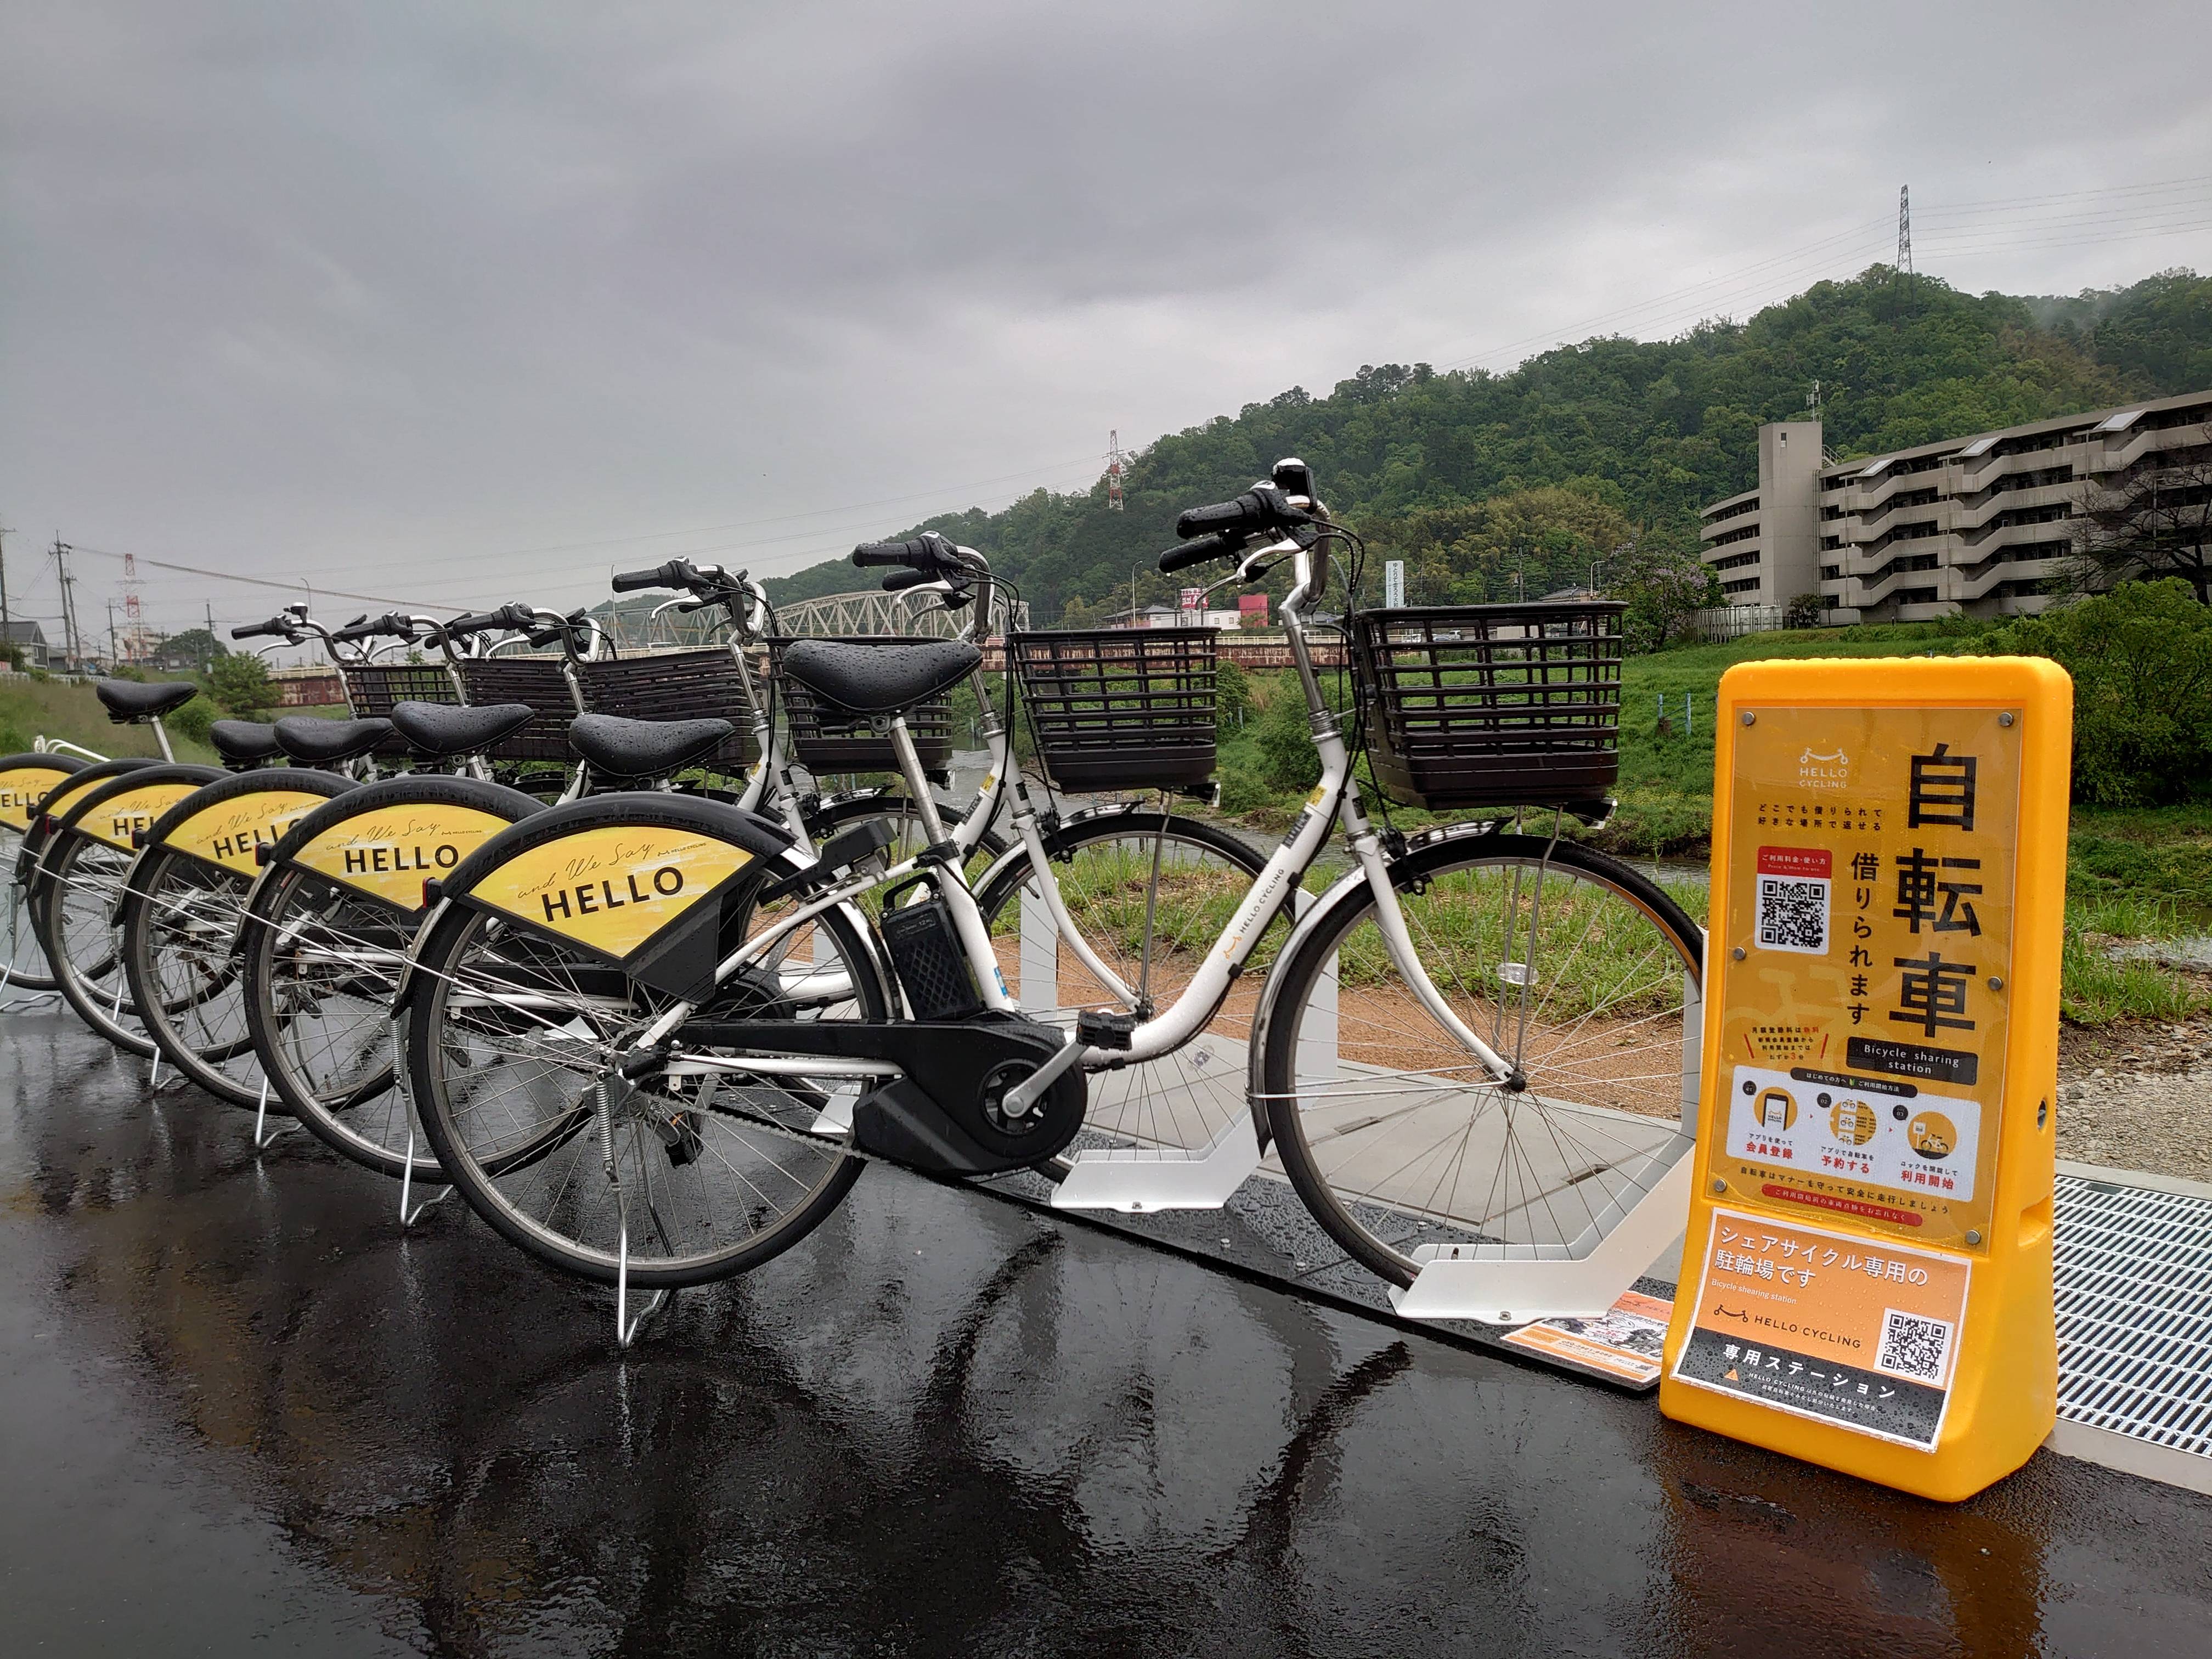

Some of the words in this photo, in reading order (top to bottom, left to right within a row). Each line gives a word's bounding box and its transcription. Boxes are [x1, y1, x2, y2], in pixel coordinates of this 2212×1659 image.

[1799, 768, 1847, 777] HELLO
[1799, 780, 1847, 788] CYCLING
[228, 812, 252, 831] We
[257, 803, 288, 819] Say
[1758, 817, 1881, 831] 好きな場所で返せる
[1759, 804, 1882, 817] どこでも借りられて
[325, 834, 358, 851] and
[366, 825, 396, 843] We
[402, 819, 441, 836] Say
[345, 844, 459, 873] HELLO
[517, 872, 556, 899] and
[565, 855, 601, 881] We
[608, 843, 654, 866] Say
[541, 866, 684, 922] HELLO
[1239, 905, 1260, 933] HELLO
[1260, 868, 1285, 904] CYCLING
[1889, 742, 1982, 1037] 自転車
[1847, 852, 1879, 1025] 借りられます
[1865, 1045, 1906, 1058] Bicycle
[1915, 1051, 1959, 1068] sharing
[1888, 1061, 1931, 1074] station
[1746, 1141, 1793, 1159] 会員登録
[1821, 1155, 1870, 1174] 予約する
[1901, 1170, 1954, 1189] 利用開始
[1714, 1249, 1816, 1288] 駐輪場です
[1720, 1226, 1928, 1286] シェアサイクル専用の
[1711, 1278, 1737, 1291] Bicycle
[1739, 1285, 1770, 1300] shearing
[1771, 1293, 1797, 1305] station
[1754, 1316, 1797, 1333] HELLO
[1803, 1328, 1861, 1348] CYCLING
[1723, 1344, 1895, 1399] 専用ステーション
[1748, 1372, 1771, 1383] HELLO
[1774, 1379, 1805, 1392] CYCLING
